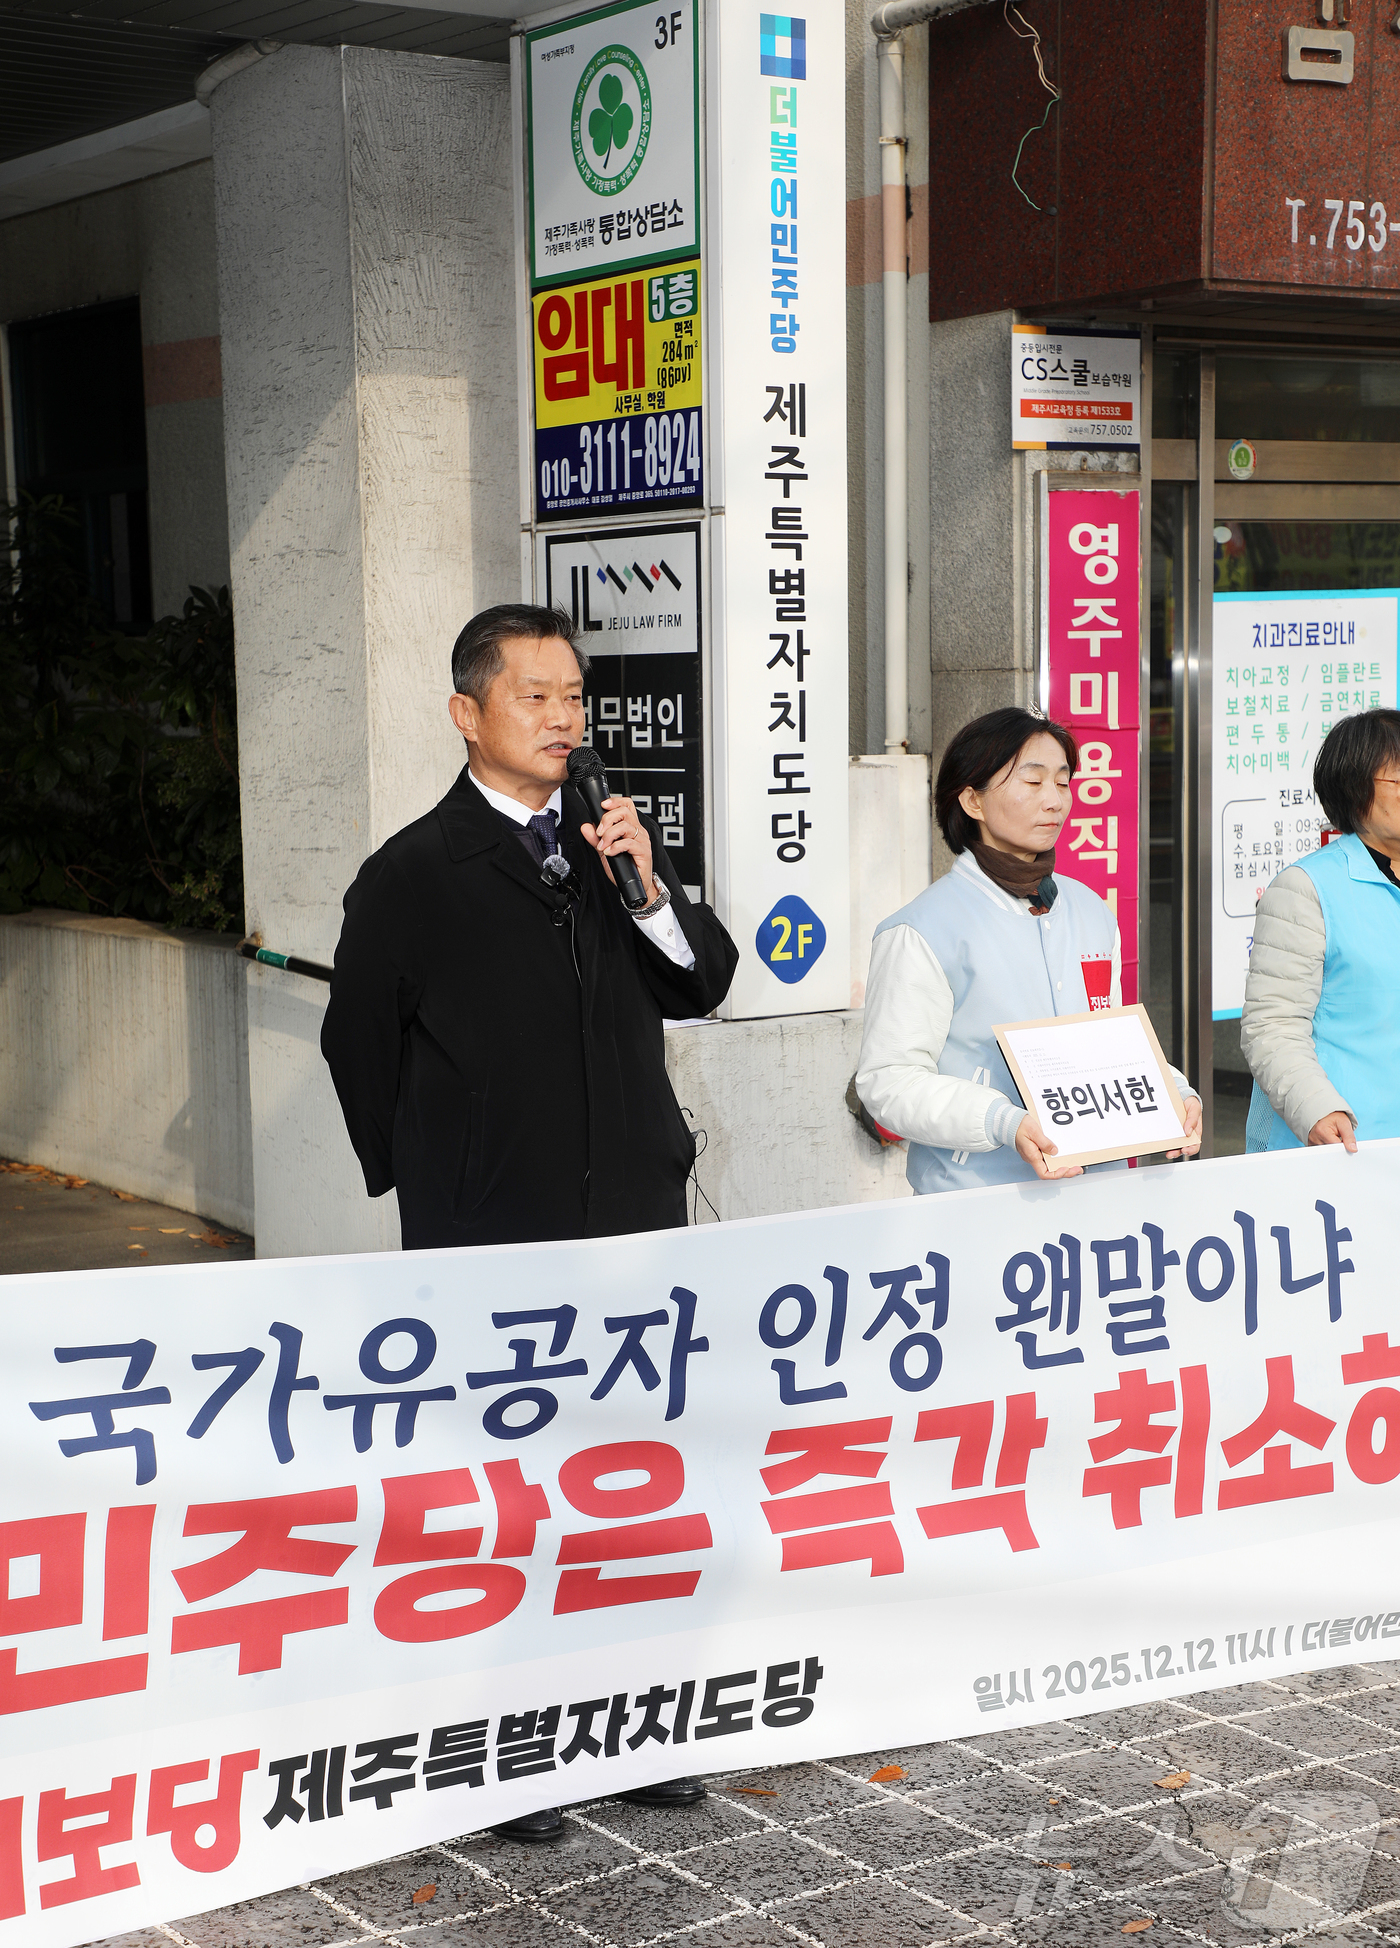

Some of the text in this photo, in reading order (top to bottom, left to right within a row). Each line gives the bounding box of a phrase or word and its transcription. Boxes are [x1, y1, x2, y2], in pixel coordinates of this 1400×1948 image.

[654, 10, 682, 49] 3F
[541, 44, 575, 62] 여성가족부지정
[594, 54, 607, 68] Love
[607, 50, 635, 68] Counseling
[633, 63, 646, 90] Center
[544, 198, 684, 245] 제주가족사랑 통합상담소
[769, 85, 801, 354] 더불어민주당
[537, 273, 694, 402] 임대 5층
[674, 319, 693, 339] 면적
[1020, 342, 1063, 355] 중등입시전문
[657, 363, 691, 389] (86py)
[614, 391, 666, 414] 사무실, 학원
[1031, 403, 1122, 416] 제주시교육청 등록 제1533호
[1090, 424, 1133, 436] 757.0502
[541, 411, 700, 499] 010-3111-8924
[608, 613, 682, 631] JEJU LAW FIRM
[762, 382, 813, 864] 제주특별자치도당
[1252, 621, 1355, 648] 치과진료안내
[1226, 664, 1289, 688] 치아교정
[1320, 662, 1382, 684] 임플란트
[1226, 694, 1290, 716] 보철치료
[1320, 690, 1382, 712] 금연치료
[1067, 522, 1123, 928] 영주미용직
[1226, 751, 1290, 775] 치아미백
[1279, 789, 1316, 808] 진료시
[770, 915, 813, 962] 2F
[1041, 1075, 1158, 1126] 항의서한
[28, 1199, 1354, 1486] 국가유공자 인정 왠말이냐
[759, 1391, 1049, 1578] 즉각
[973, 1667, 1035, 1713] 일시
[1042, 1638, 1218, 1700] 2025.12.12
[1225, 1626, 1278, 1666] 11시
[262, 1656, 824, 1831] 제주특별자치도당
